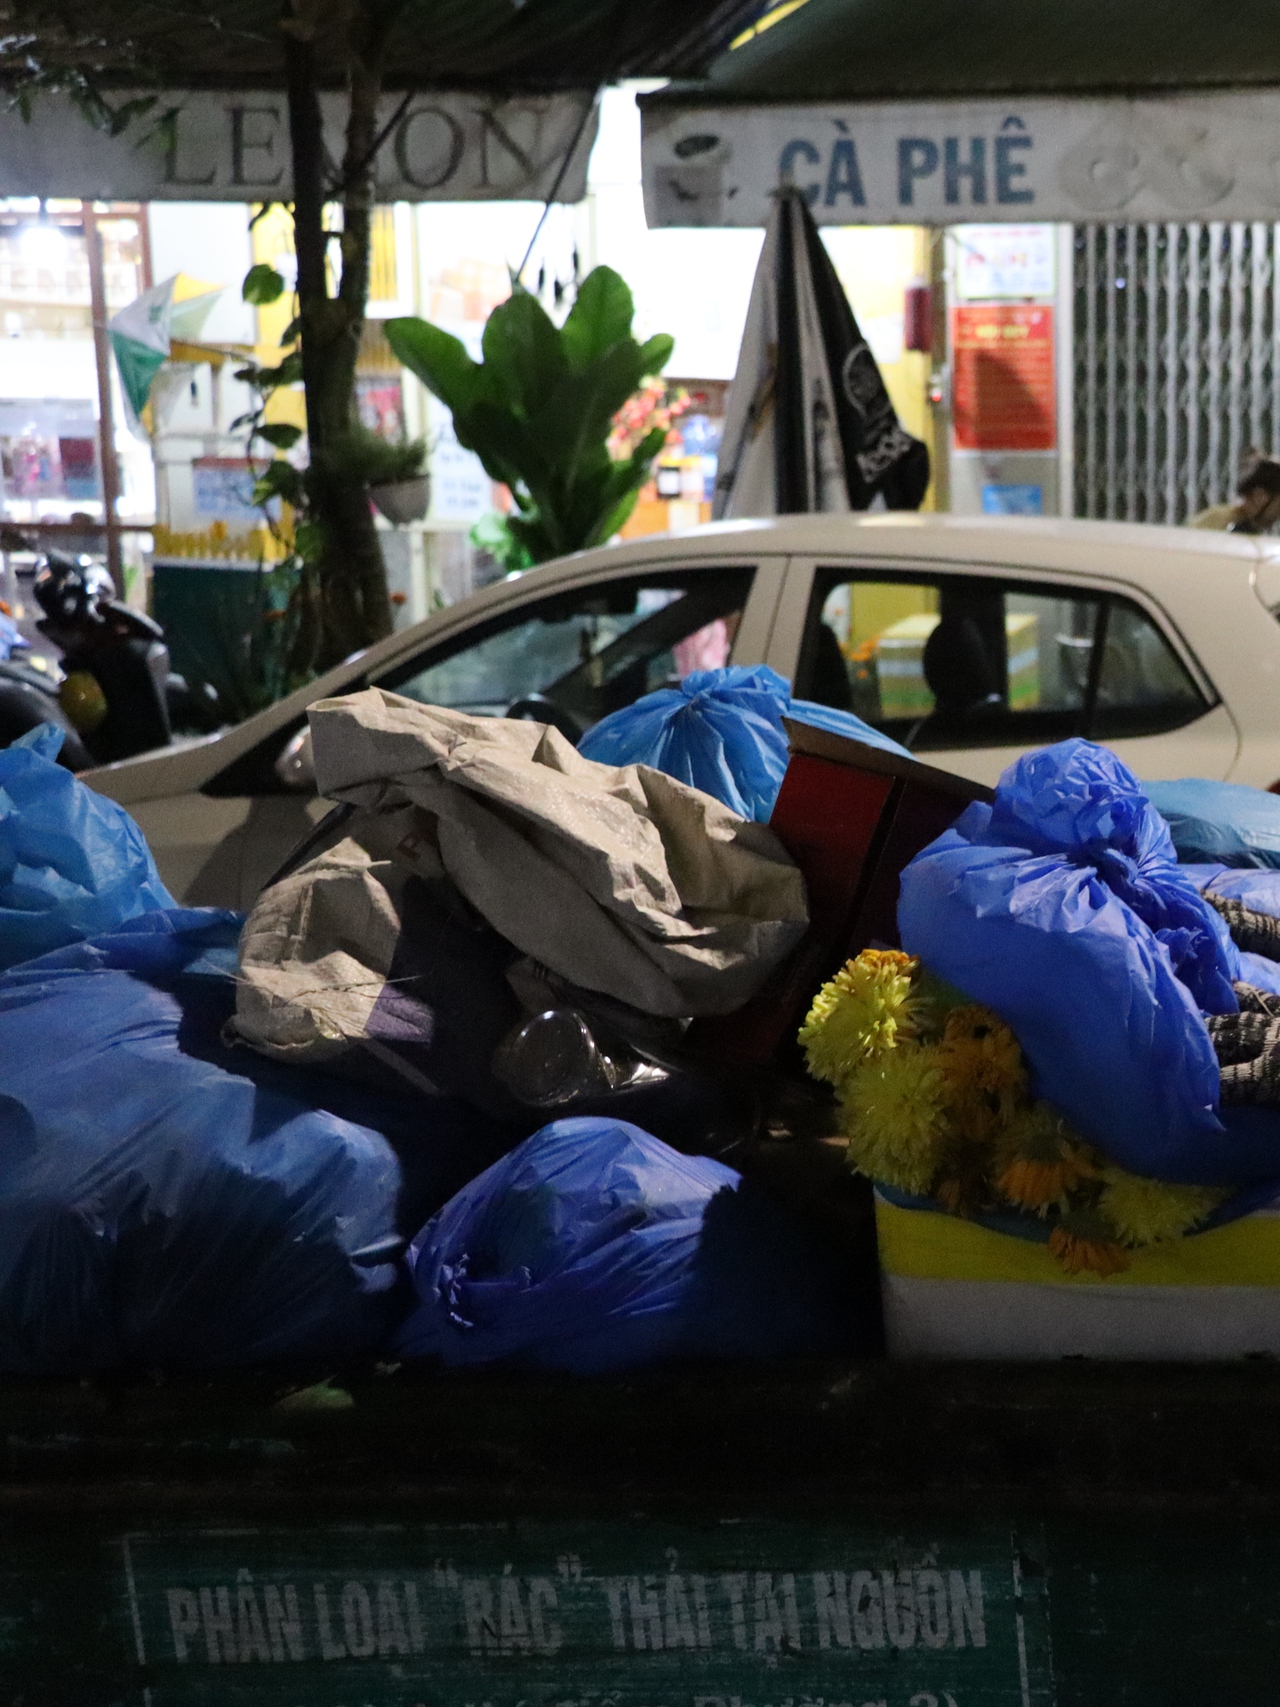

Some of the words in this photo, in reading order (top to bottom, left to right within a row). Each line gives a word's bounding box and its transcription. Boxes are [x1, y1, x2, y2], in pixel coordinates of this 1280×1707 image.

[163, 104, 553, 189] LEON
[778, 118, 868, 208] CÀ
[896, 114, 1035, 206] PHÊ
[167, 1566, 306, 1664] PHÂN
[599, 1546, 712, 1651] THẢI
